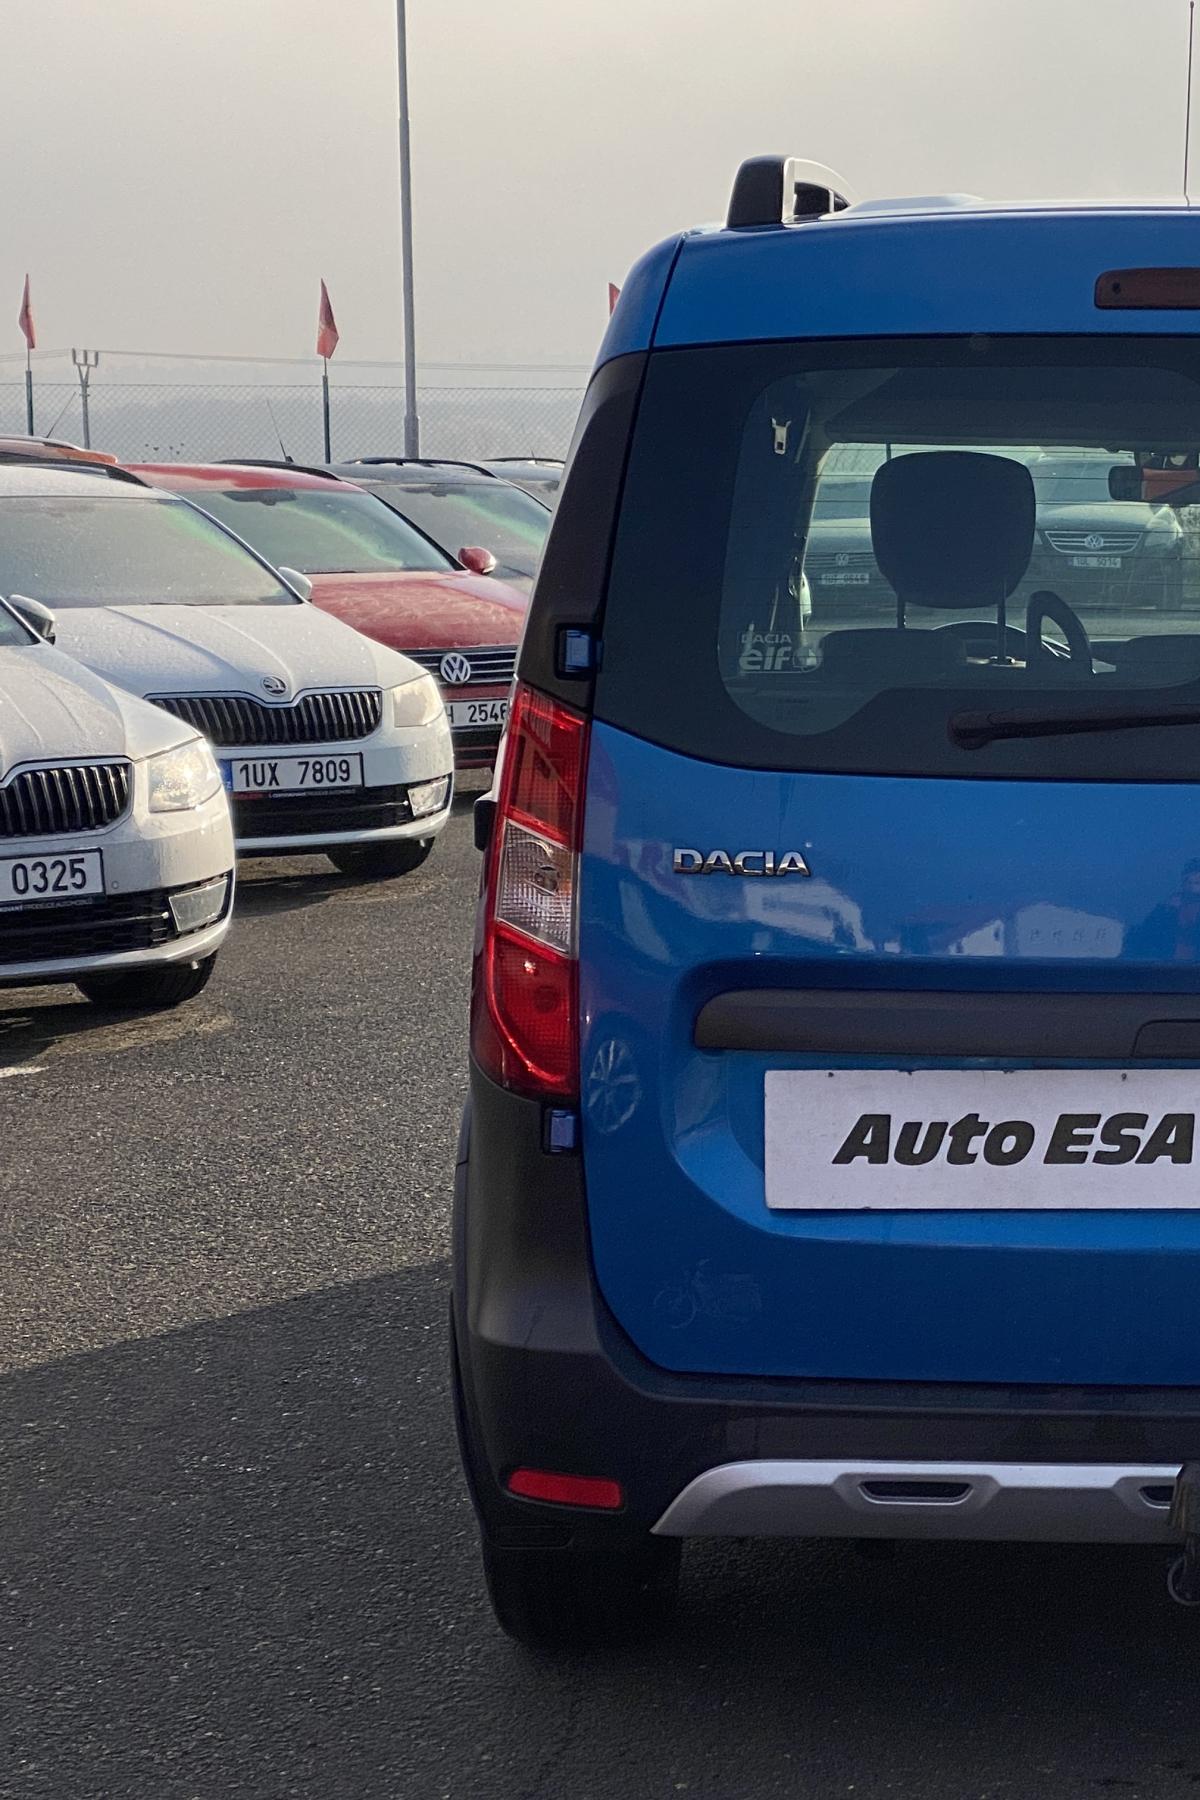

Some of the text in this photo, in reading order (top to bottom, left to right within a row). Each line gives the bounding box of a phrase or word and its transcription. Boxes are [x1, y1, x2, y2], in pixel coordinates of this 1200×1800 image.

[739, 646, 792, 670] elf
[239, 759, 350, 788] 1UX 7809
[11, 857, 87, 895] 0325
[672, 848, 810, 877] DACIA
[832, 1112, 1195, 1166] Auto ESA
